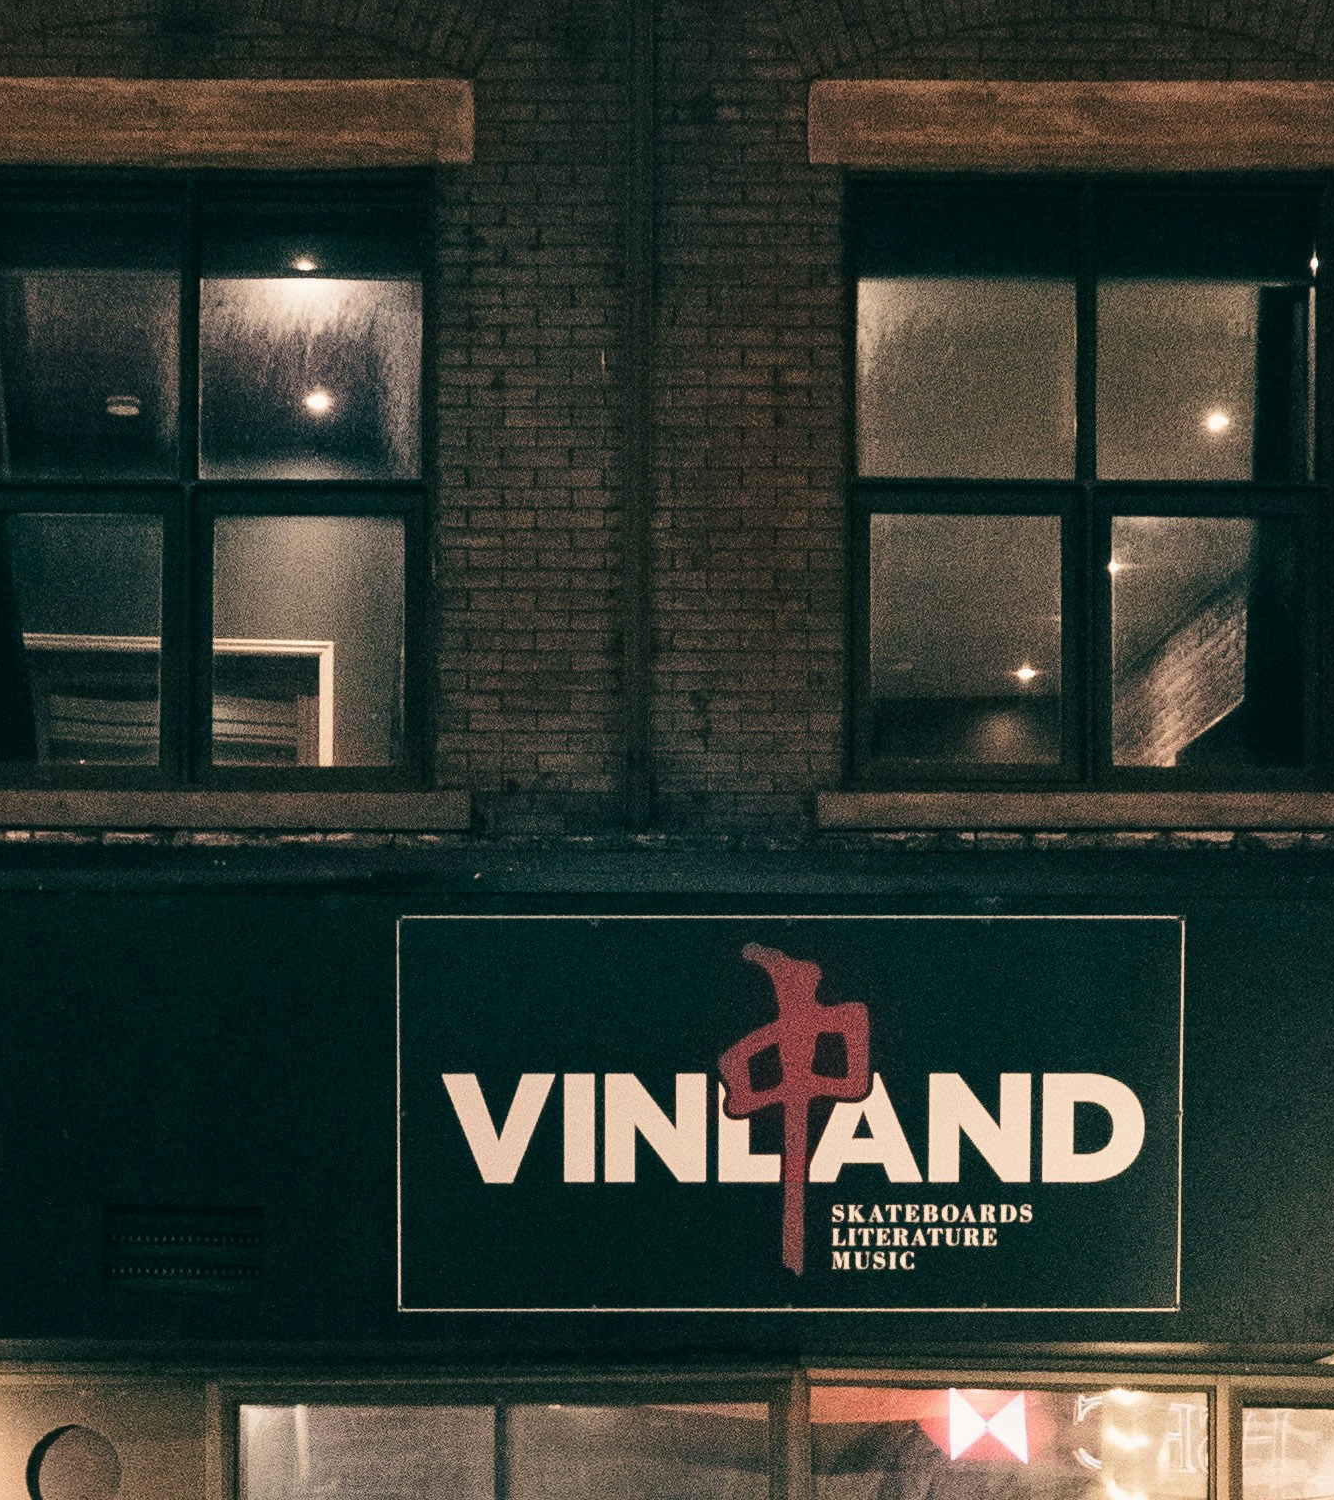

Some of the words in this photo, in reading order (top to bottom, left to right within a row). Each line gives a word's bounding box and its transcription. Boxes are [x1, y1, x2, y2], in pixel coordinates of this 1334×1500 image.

[442, 1073, 1145, 1184] VINLAND
[831, 1204, 1034, 1224] SKATEBOARDS
[832, 1228, 998, 1247] LITERATURE
[832, 1251, 916, 1271] MUSIC
